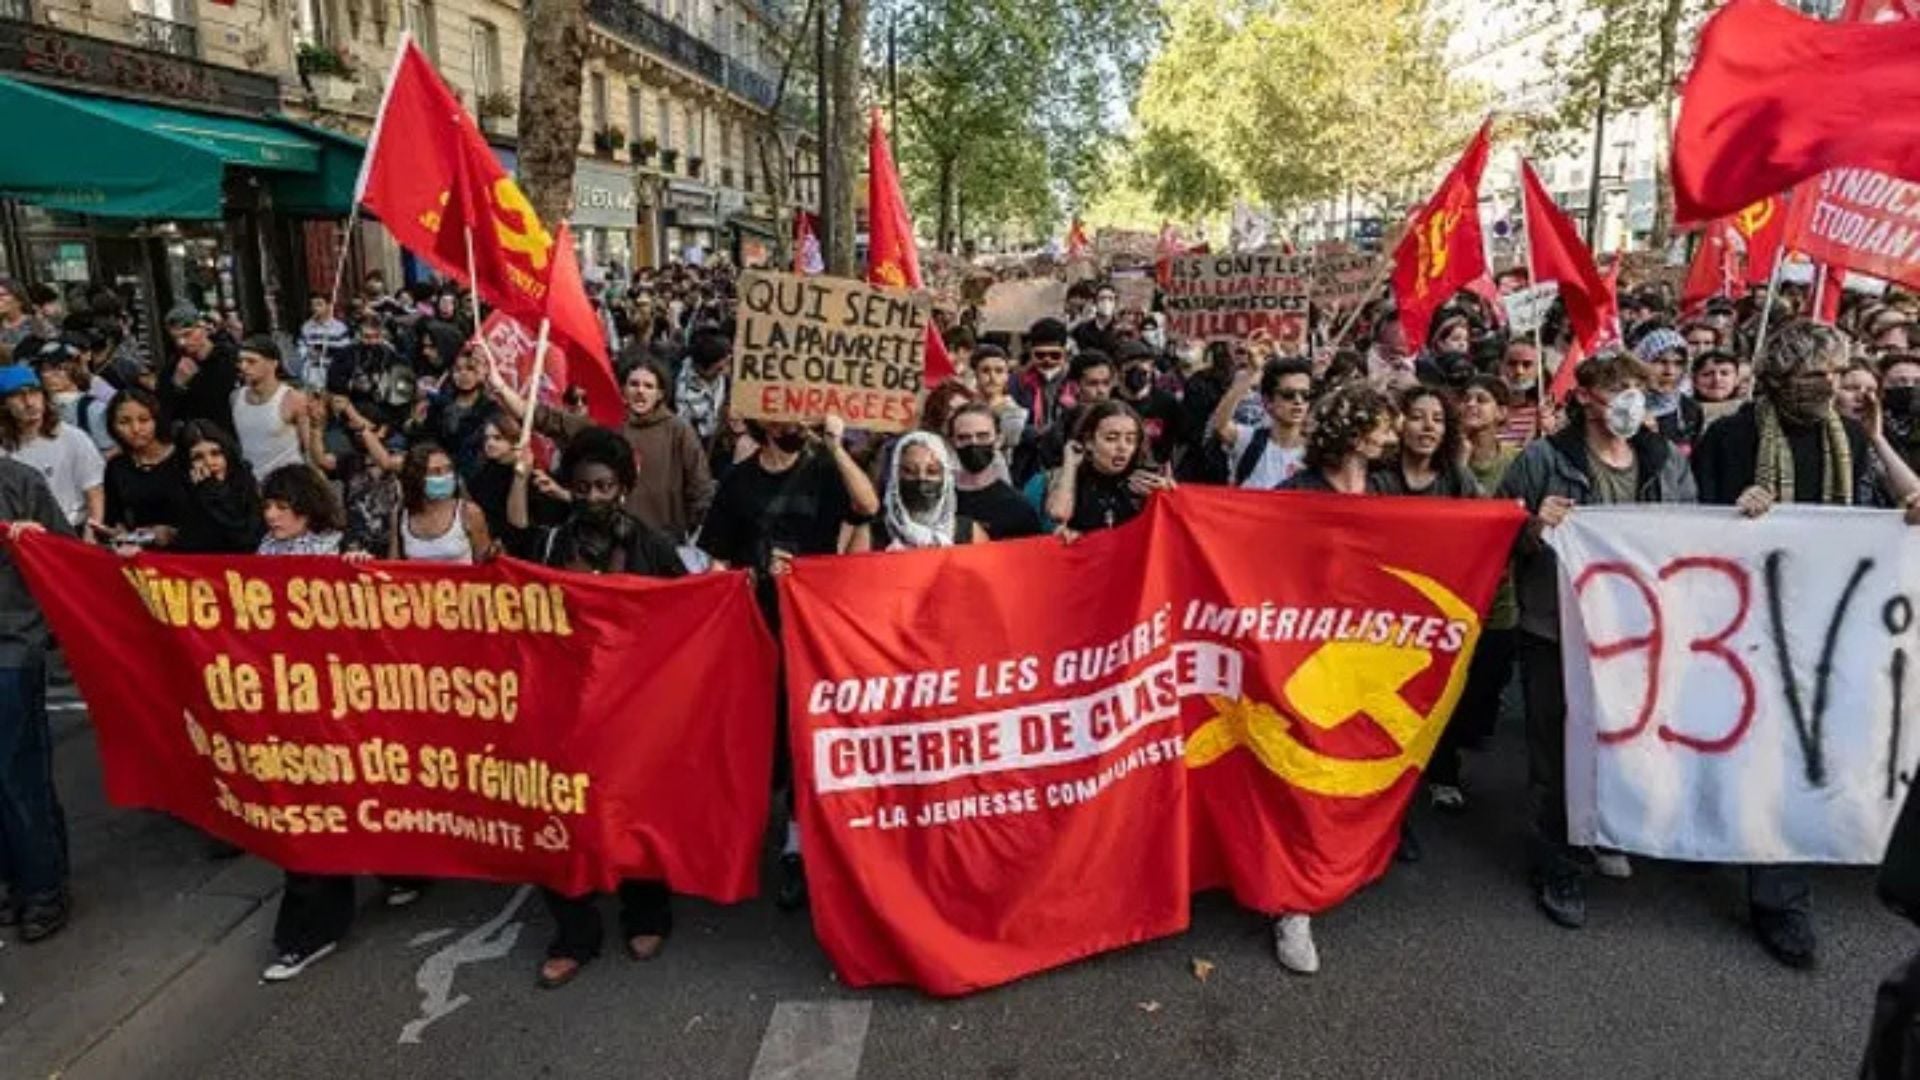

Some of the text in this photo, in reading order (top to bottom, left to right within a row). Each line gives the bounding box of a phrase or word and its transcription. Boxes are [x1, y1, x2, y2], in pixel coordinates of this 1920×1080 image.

[1215, 256, 1271, 278] ONT
[746, 279, 831, 323] QUI
[744, 319, 790, 350] LA
[883, 365, 923, 393] DES
[121, 566, 221, 629] Vive
[225, 569, 275, 631] le
[807, 668, 960, 715] CONTRE
[975, 655, 1038, 699] LES
[1182, 599, 1468, 652] IMPÉRIALISTES
[1574, 555, 1756, 754] 93
[204, 653, 519, 724] de la jeunesse
[212, 732, 237, 774] a
[358, 737, 411, 785] de
[418, 745, 460, 790] se
[466, 743, 590, 814] révolter
[829, 722, 1001, 780] GUERRE
[1019, 711, 1074, 755] DE
[878, 805, 909, 829] LA
[917, 788, 1038, 826] JEUNESSE
